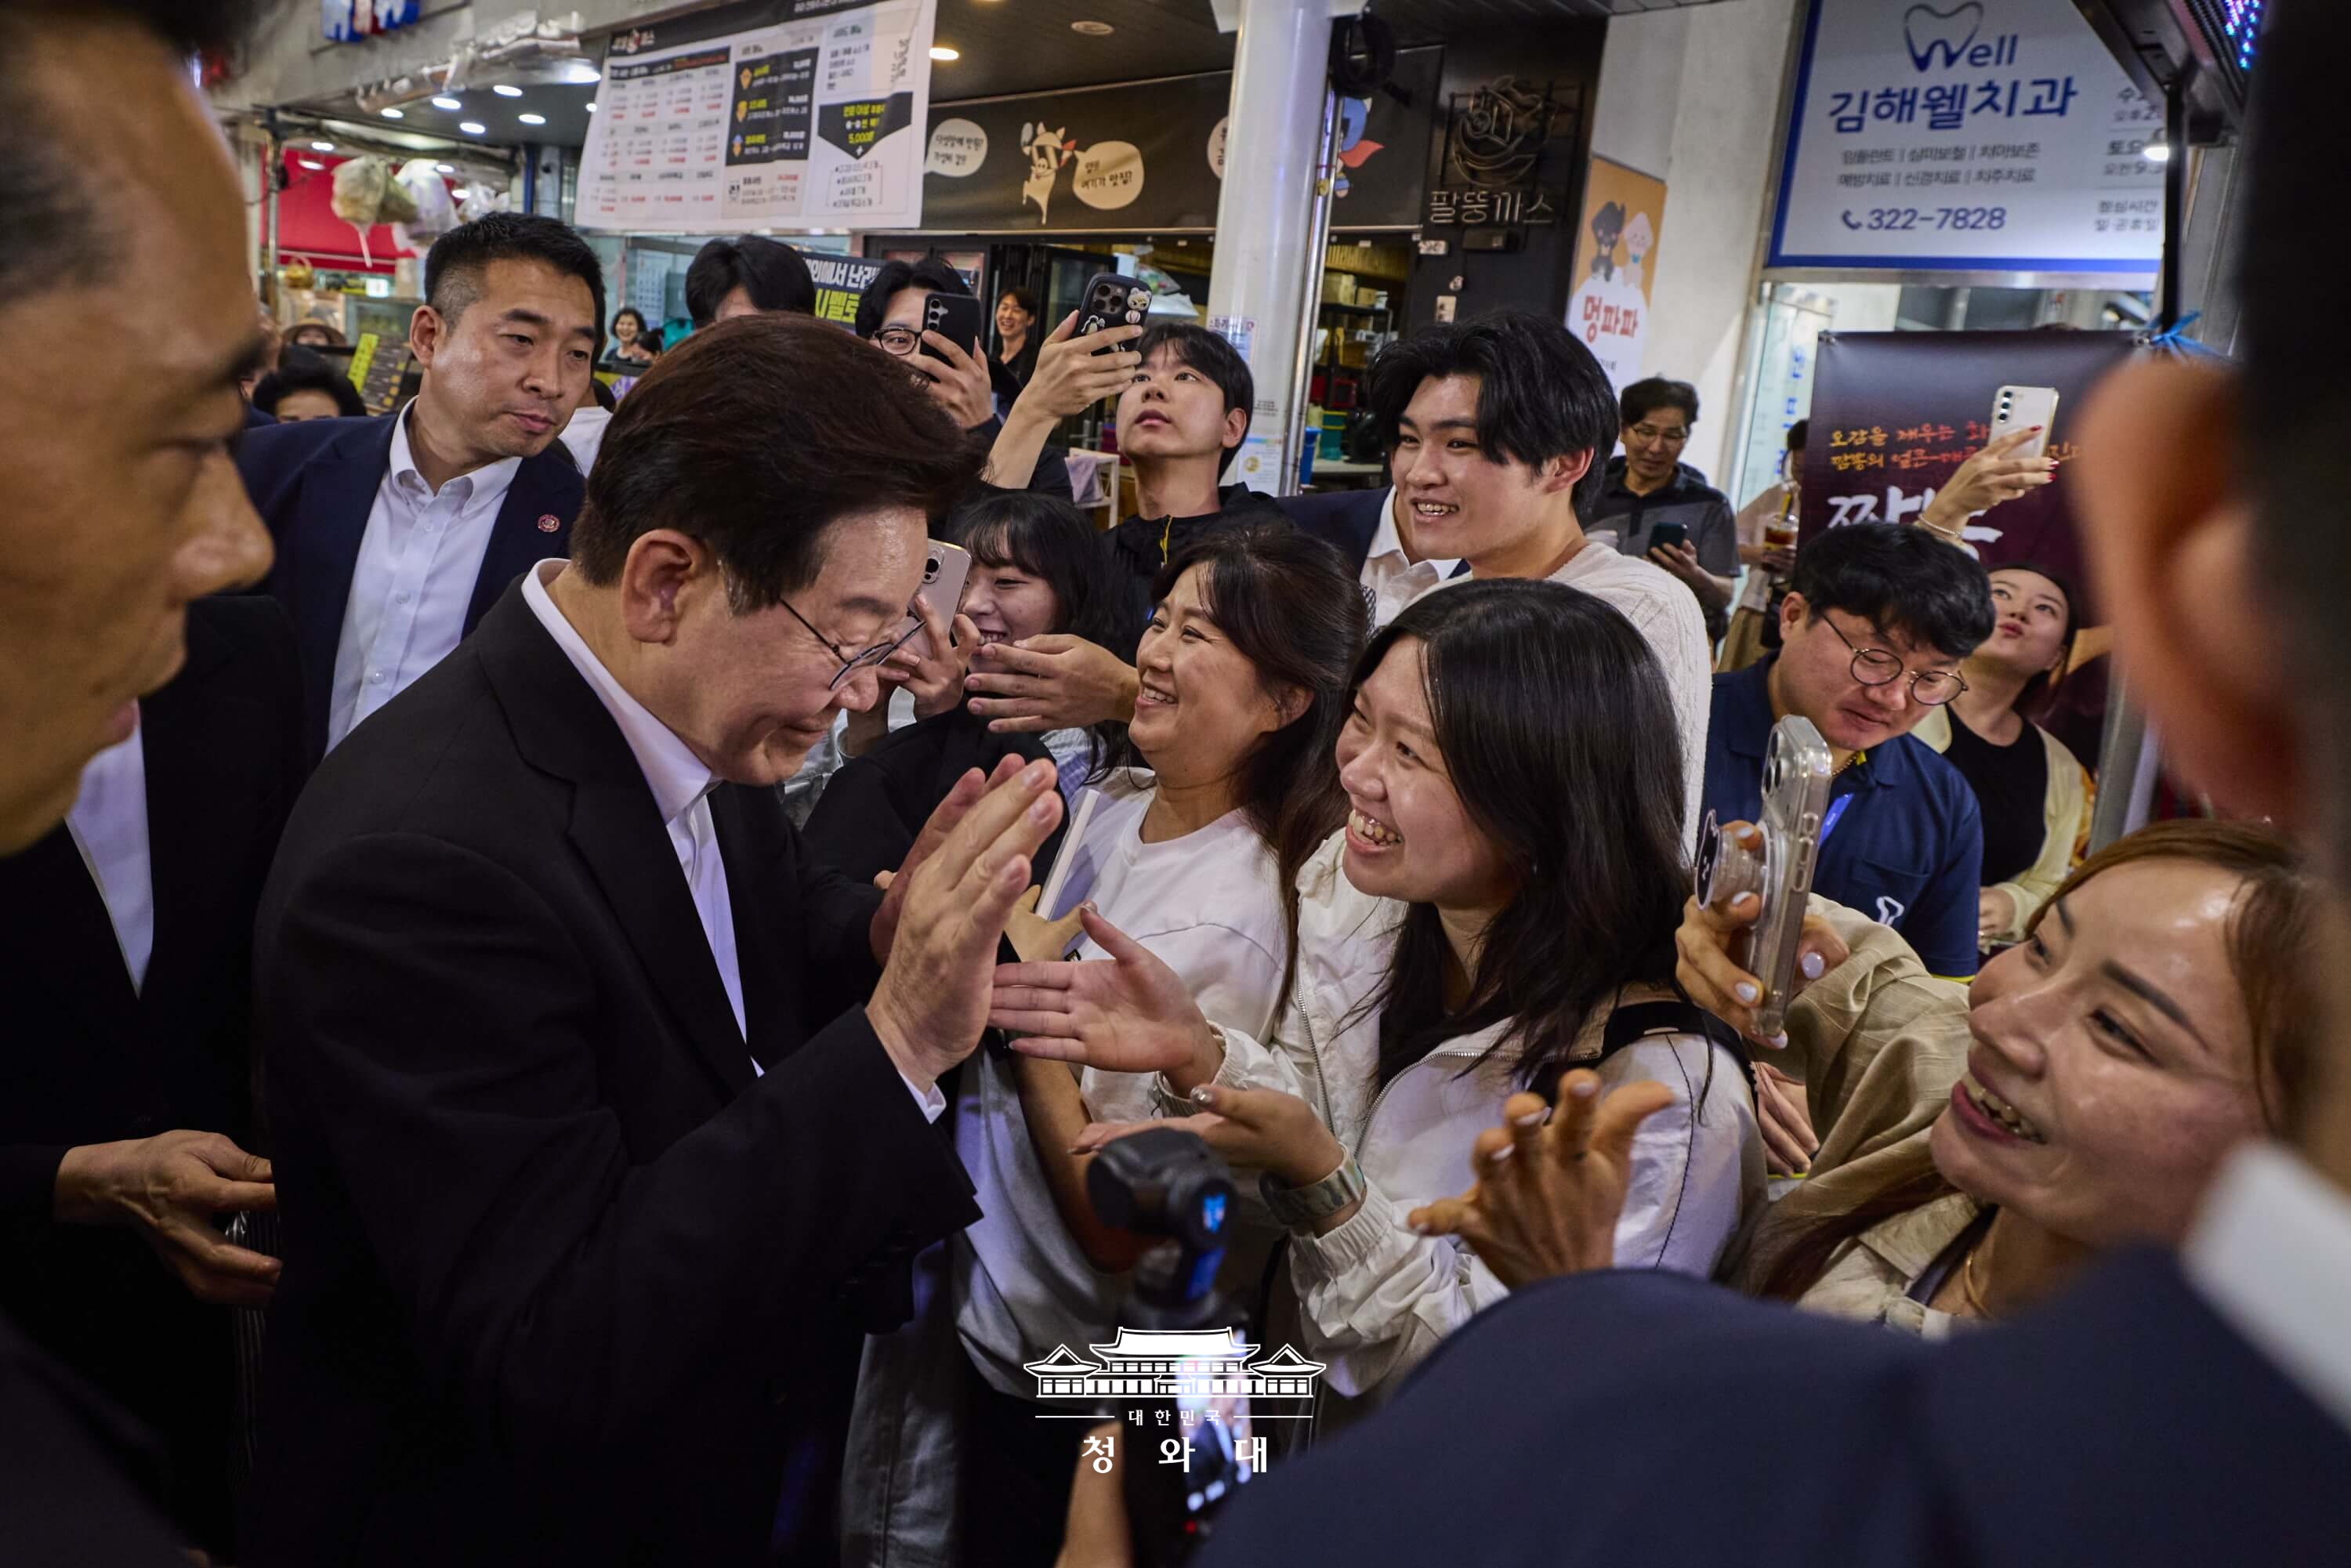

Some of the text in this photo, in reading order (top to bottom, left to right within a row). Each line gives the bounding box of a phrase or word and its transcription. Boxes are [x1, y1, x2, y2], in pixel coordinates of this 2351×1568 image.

[1904, 11, 2019, 72] Well
[1828, 77, 2079, 134] 김해웰치과
[1842, 147, 1896, 165] 임플란트
[1430, 190, 1553, 223] 팔뚱까스
[1866, 207, 2007, 230] 322-7828
[1583, 295, 1639, 344] 멍파파
[1828, 425, 1889, 448] 오감을
